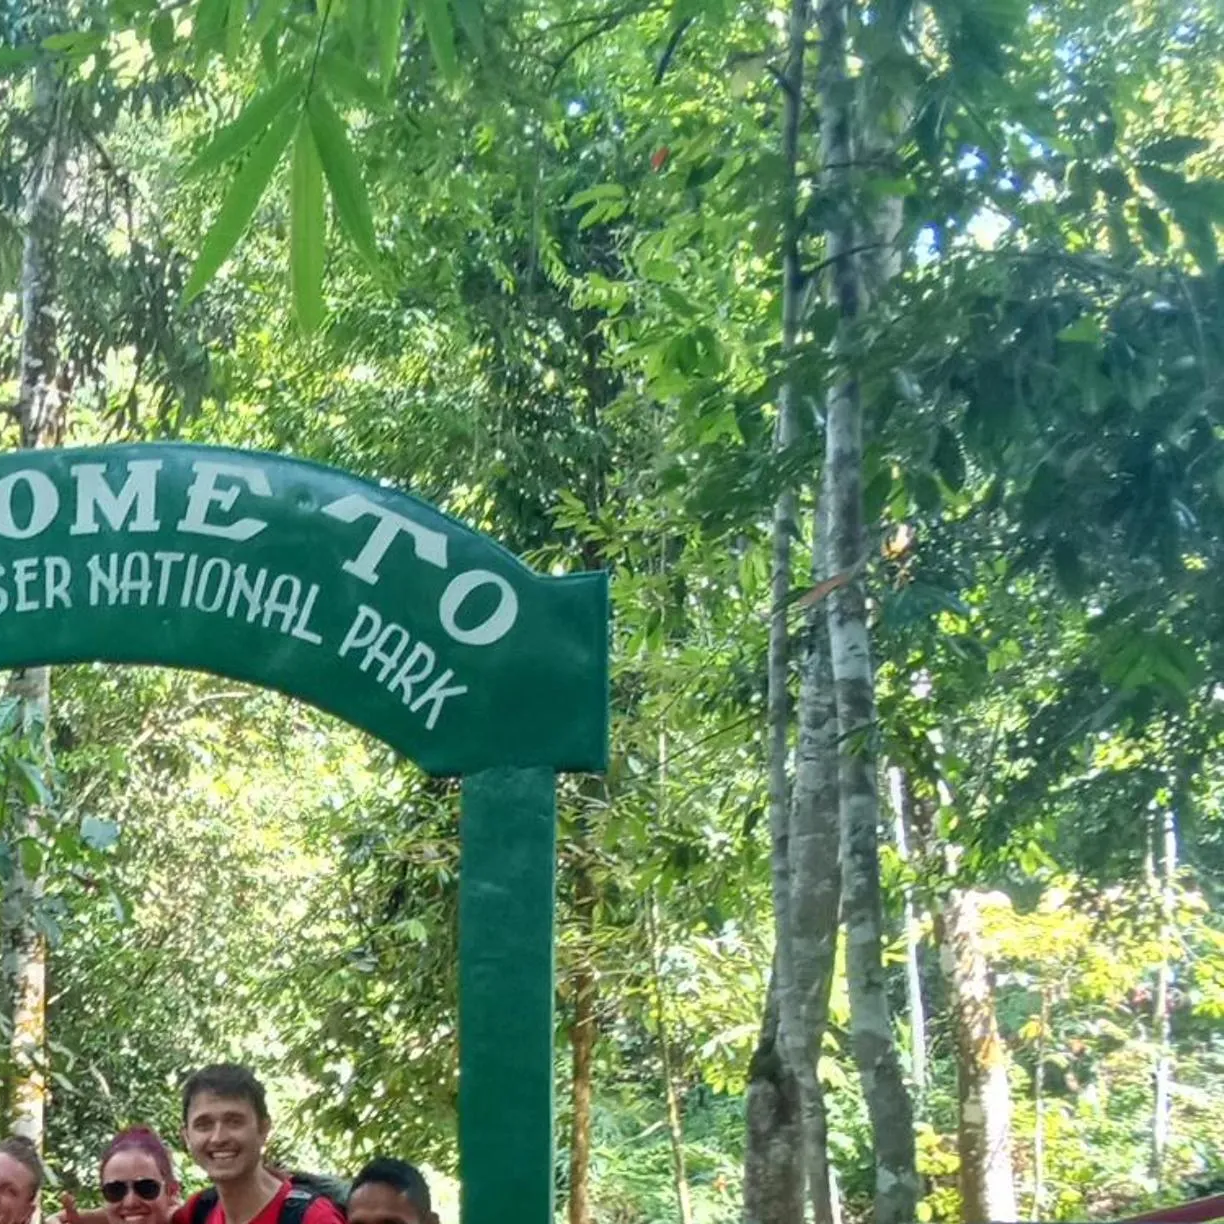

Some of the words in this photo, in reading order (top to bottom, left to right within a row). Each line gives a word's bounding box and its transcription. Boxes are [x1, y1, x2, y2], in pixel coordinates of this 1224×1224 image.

[87, 551, 323, 645] NATIONAL
[337, 603, 468, 731] PARK
[320, 493, 519, 646] TO
